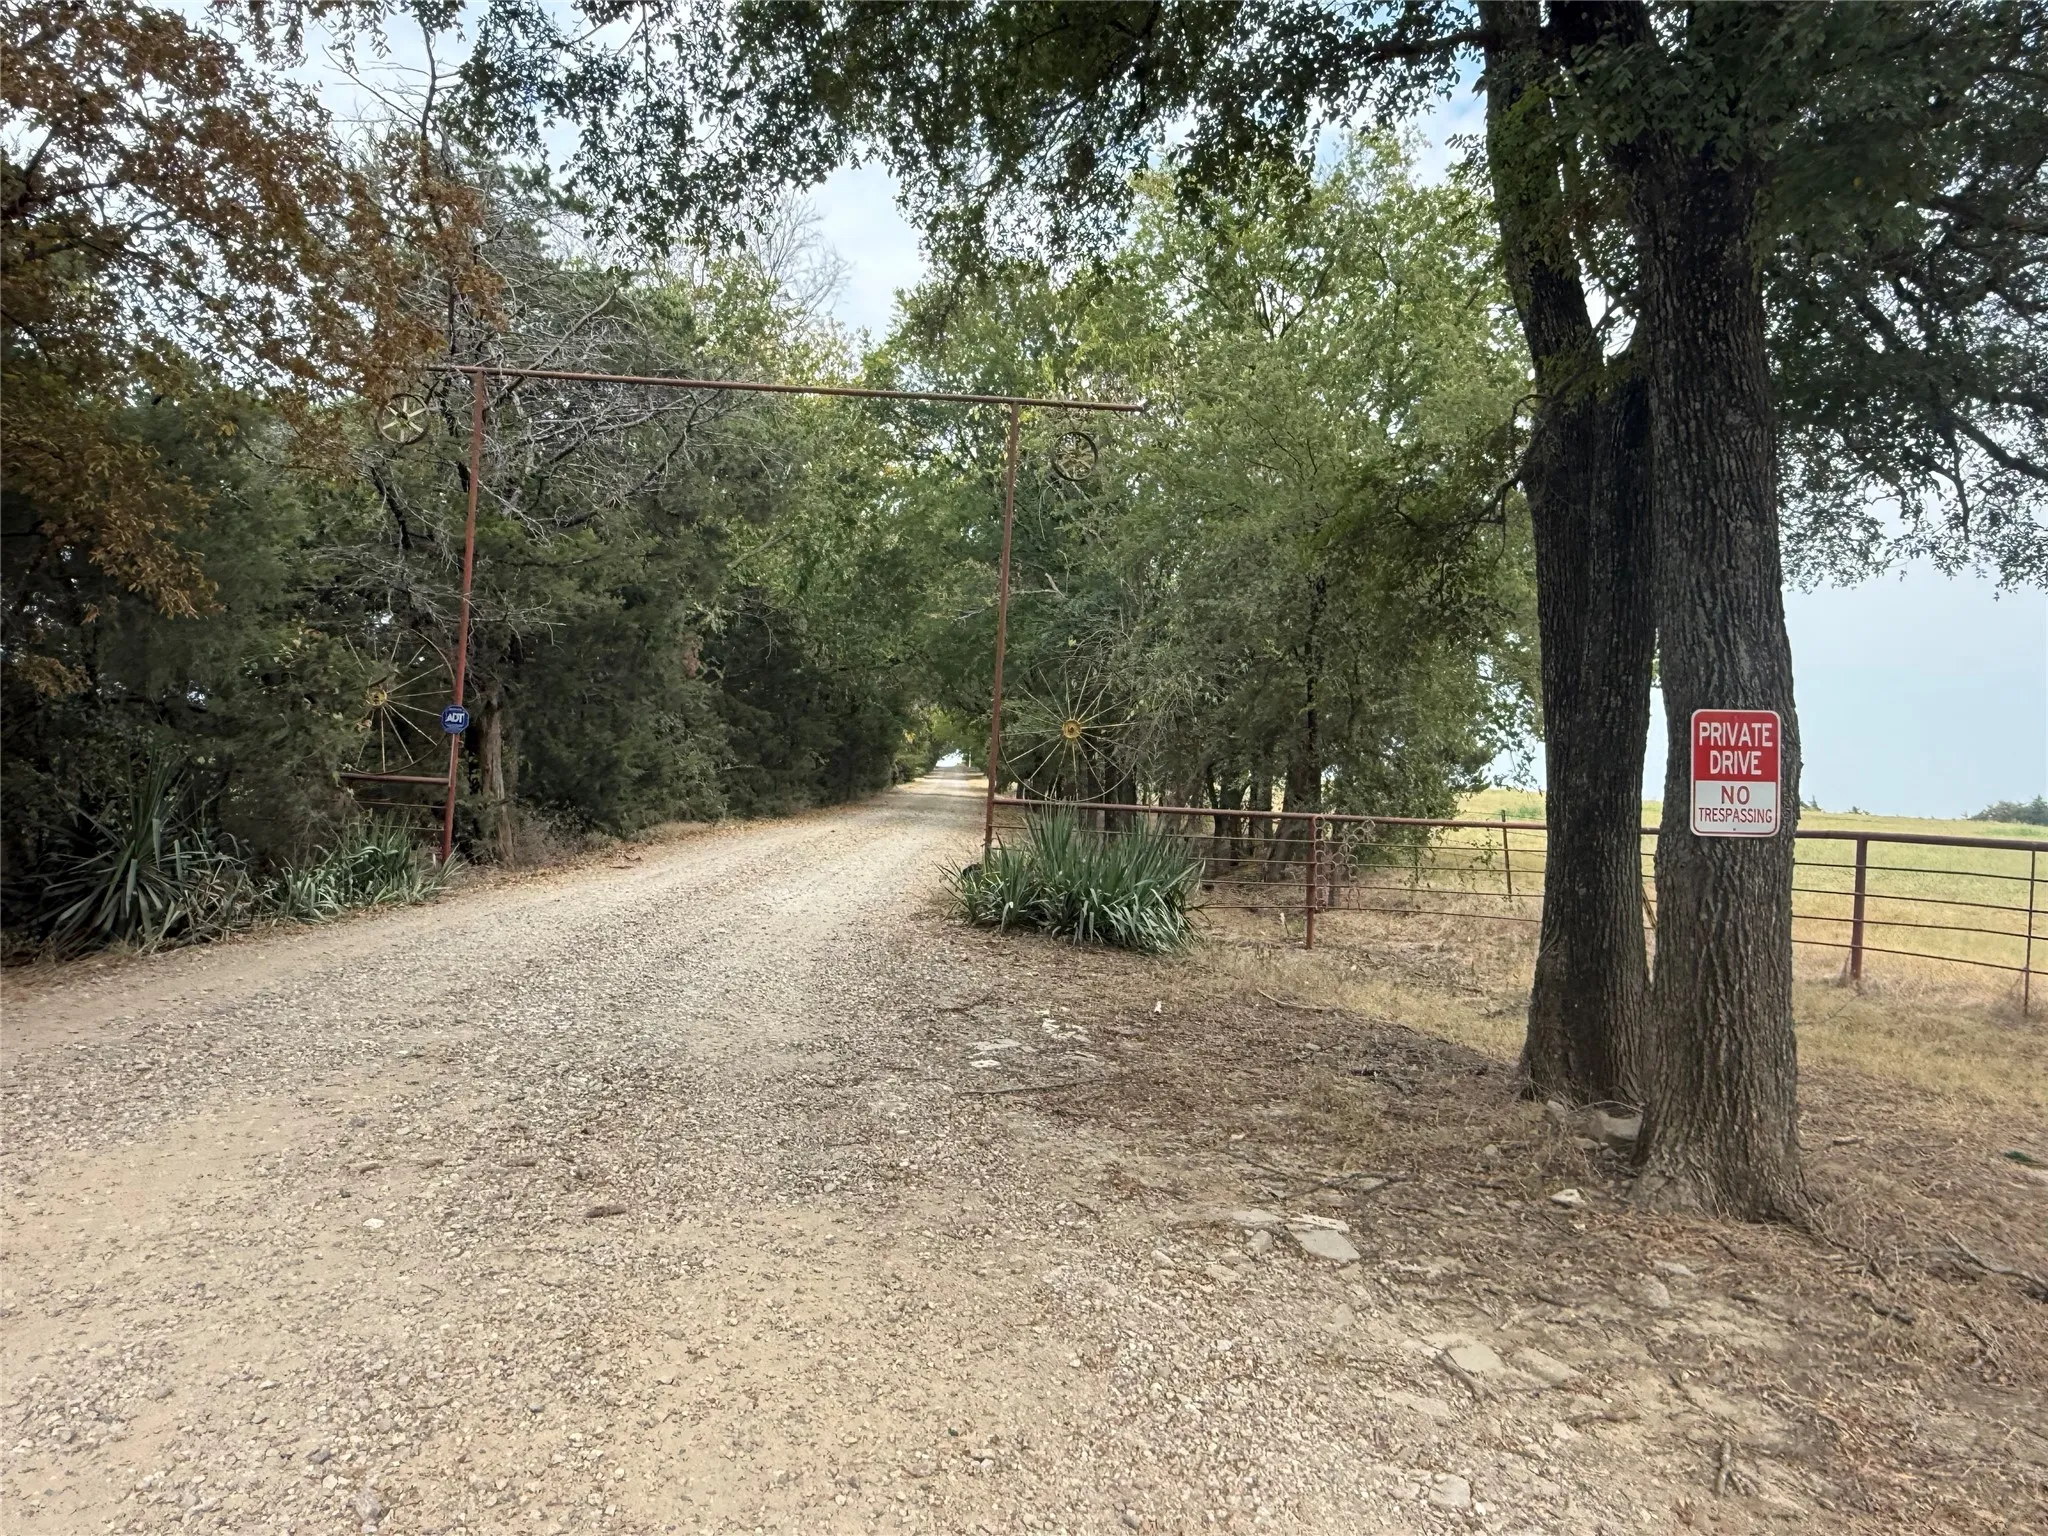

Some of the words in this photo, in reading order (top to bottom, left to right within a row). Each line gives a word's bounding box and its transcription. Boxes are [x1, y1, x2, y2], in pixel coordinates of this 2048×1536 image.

[445, 712, 465, 723] ADT
[1698, 722, 1773, 747] PRIVATE
[1710, 750, 1762, 775] DRIVE
[1721, 785, 1750, 805] NO
[1698, 807, 1772, 823] TRESPASSING
